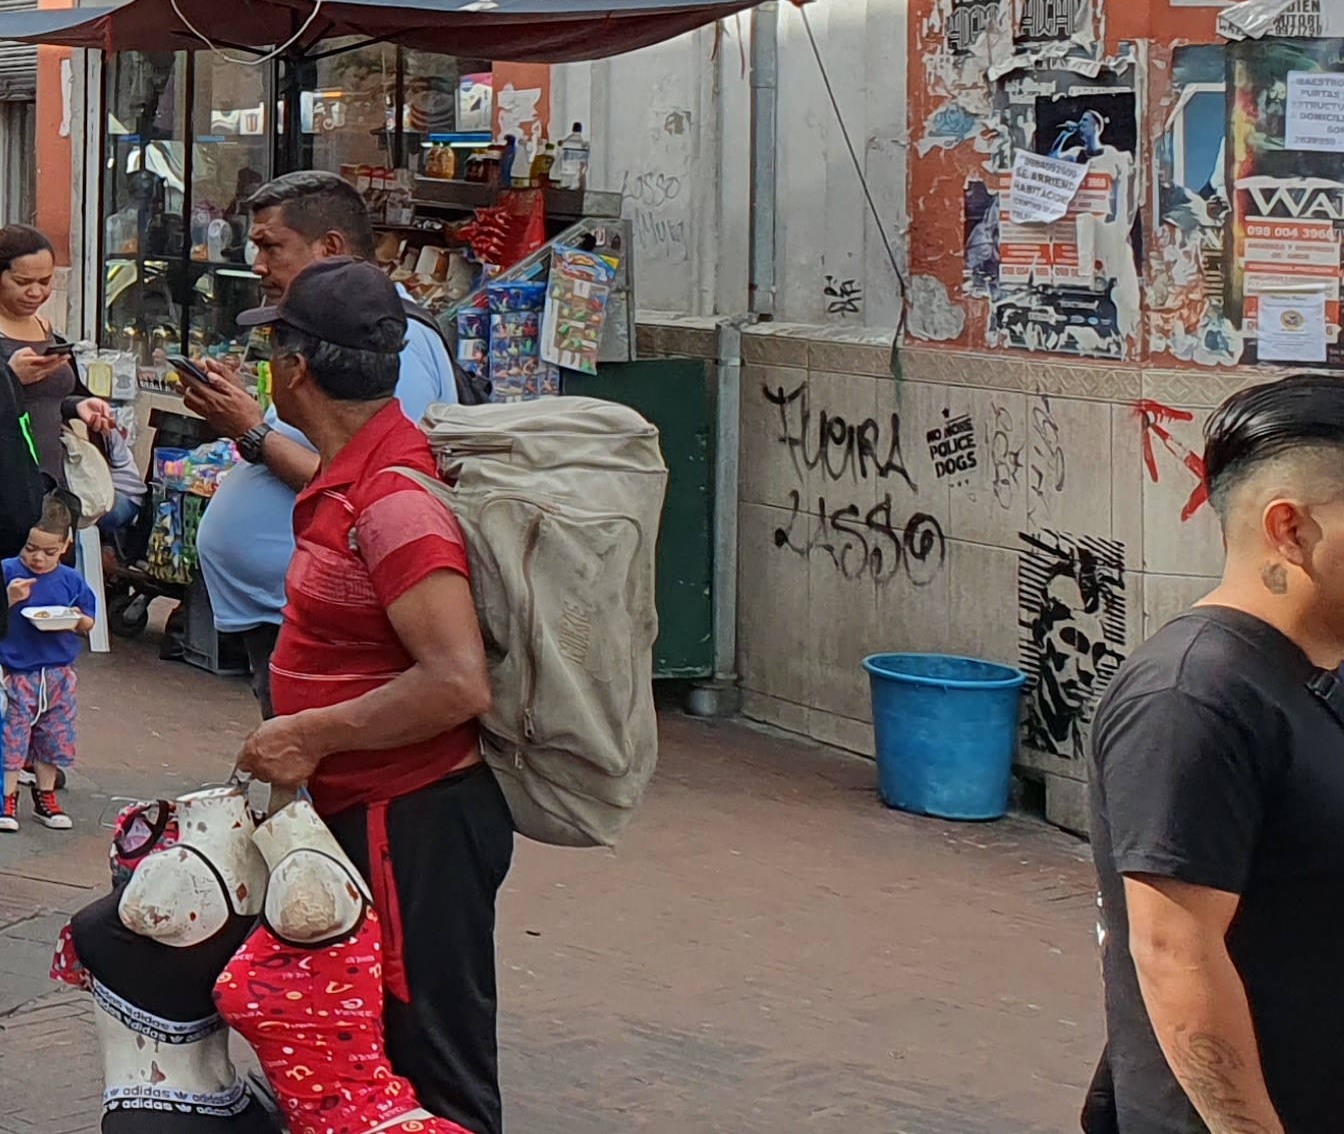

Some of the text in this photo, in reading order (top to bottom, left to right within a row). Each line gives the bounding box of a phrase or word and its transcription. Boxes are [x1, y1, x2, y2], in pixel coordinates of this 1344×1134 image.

[1249, 184, 1344, 219] WA
[926, 428, 942, 443] NO
[929, 433, 976, 460] POLICE
[935, 451, 978, 479] DOGS
[130, 1020, 168, 1043] adidas
[123, 1085, 171, 1099] adidas
[121, 1098, 174, 1112] adidas
